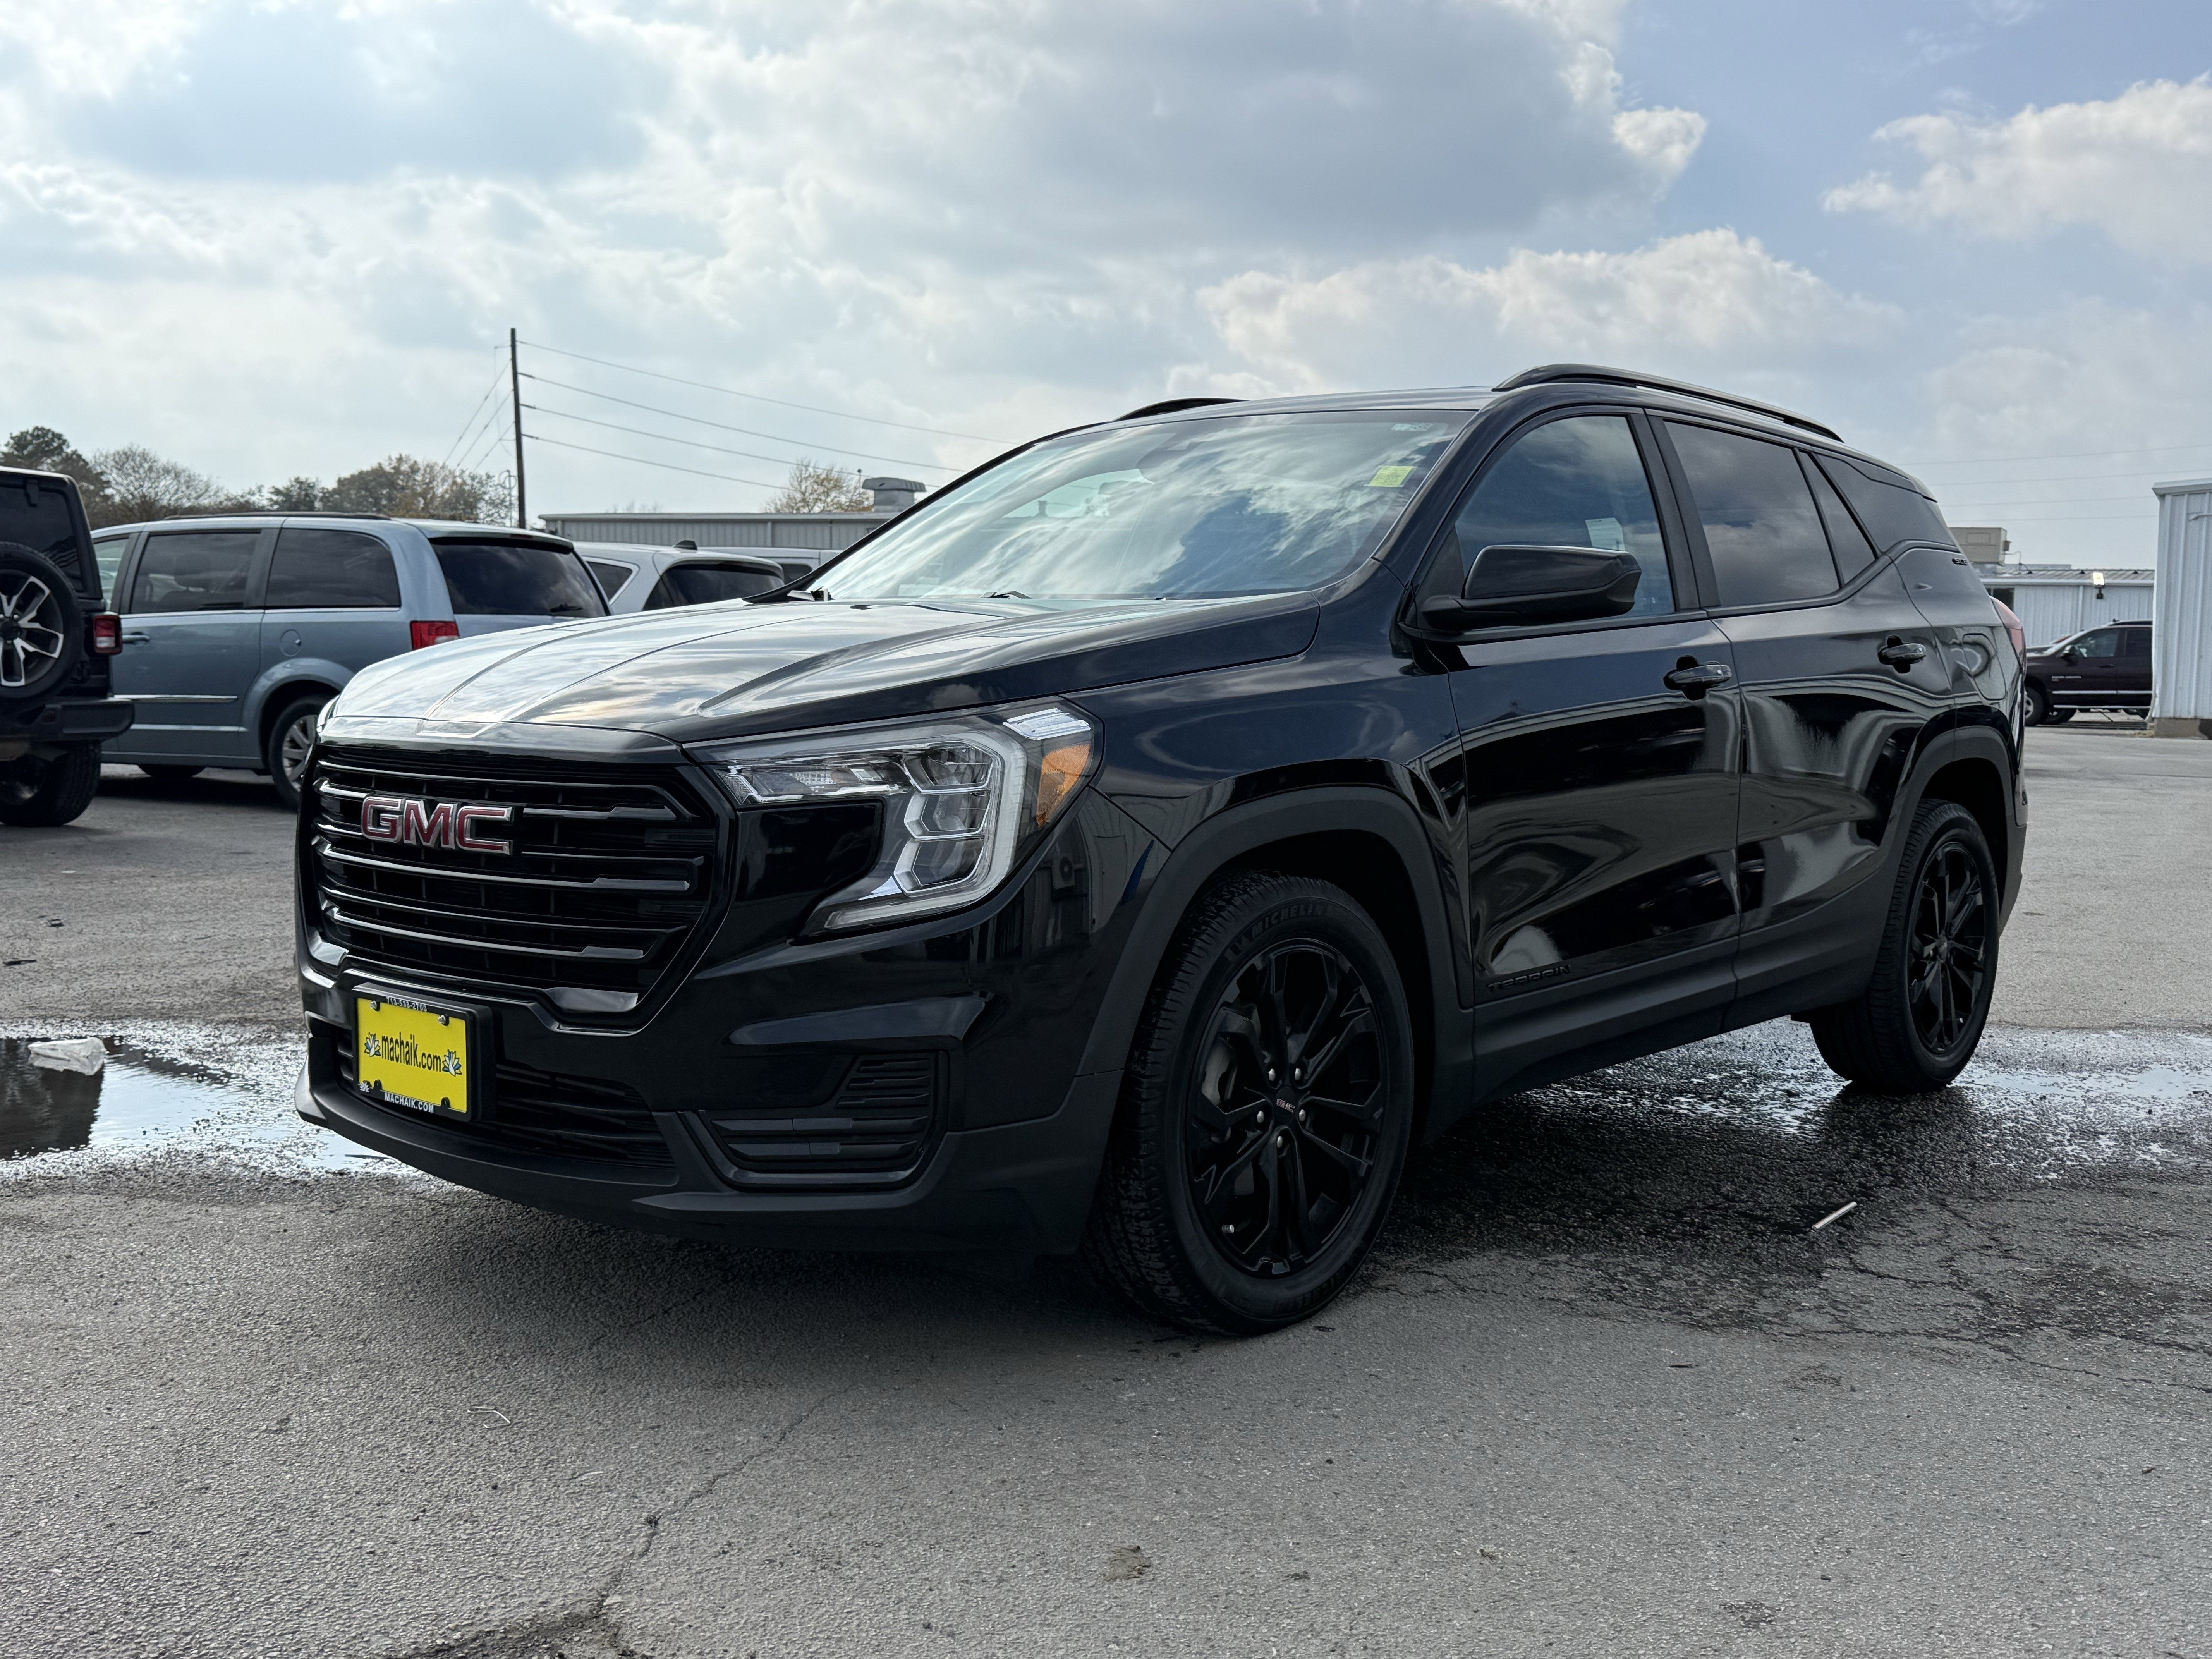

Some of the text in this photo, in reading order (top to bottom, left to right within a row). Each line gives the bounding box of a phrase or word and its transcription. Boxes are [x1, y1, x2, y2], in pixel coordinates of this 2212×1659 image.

[361, 796, 513, 855] GMC
[1486, 965, 1571, 991] TERRAIN
[386, 996, 427, 1012] 713-538-2700
[381, 1032, 441, 1072] machaik.com
[384, 1092, 434, 1113] MACHAIK.COM
[1276, 1098, 1295, 1113] GMC
